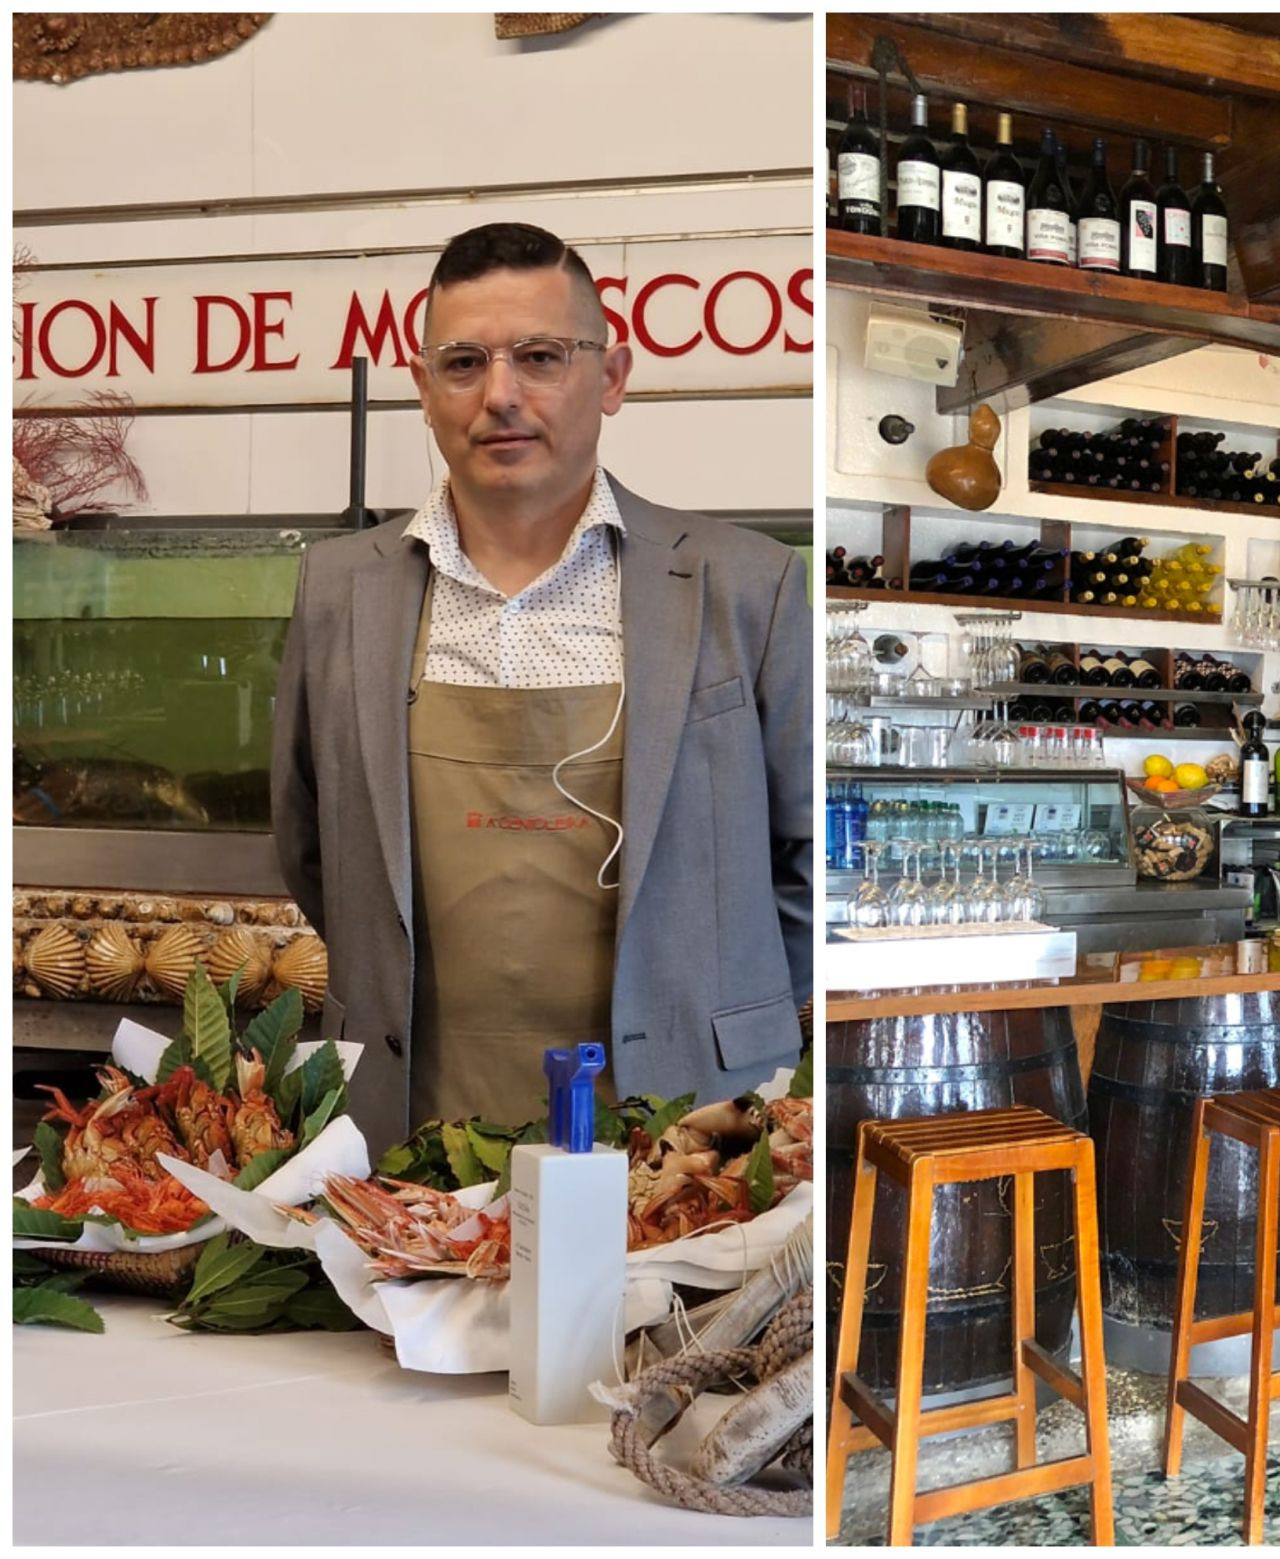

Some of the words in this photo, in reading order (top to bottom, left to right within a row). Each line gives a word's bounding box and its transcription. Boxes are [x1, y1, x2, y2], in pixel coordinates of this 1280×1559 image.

[13, 296, 159, 380] ION
[193, 290, 300, 374] DE
[328, 267, 813, 370] MSCOS
